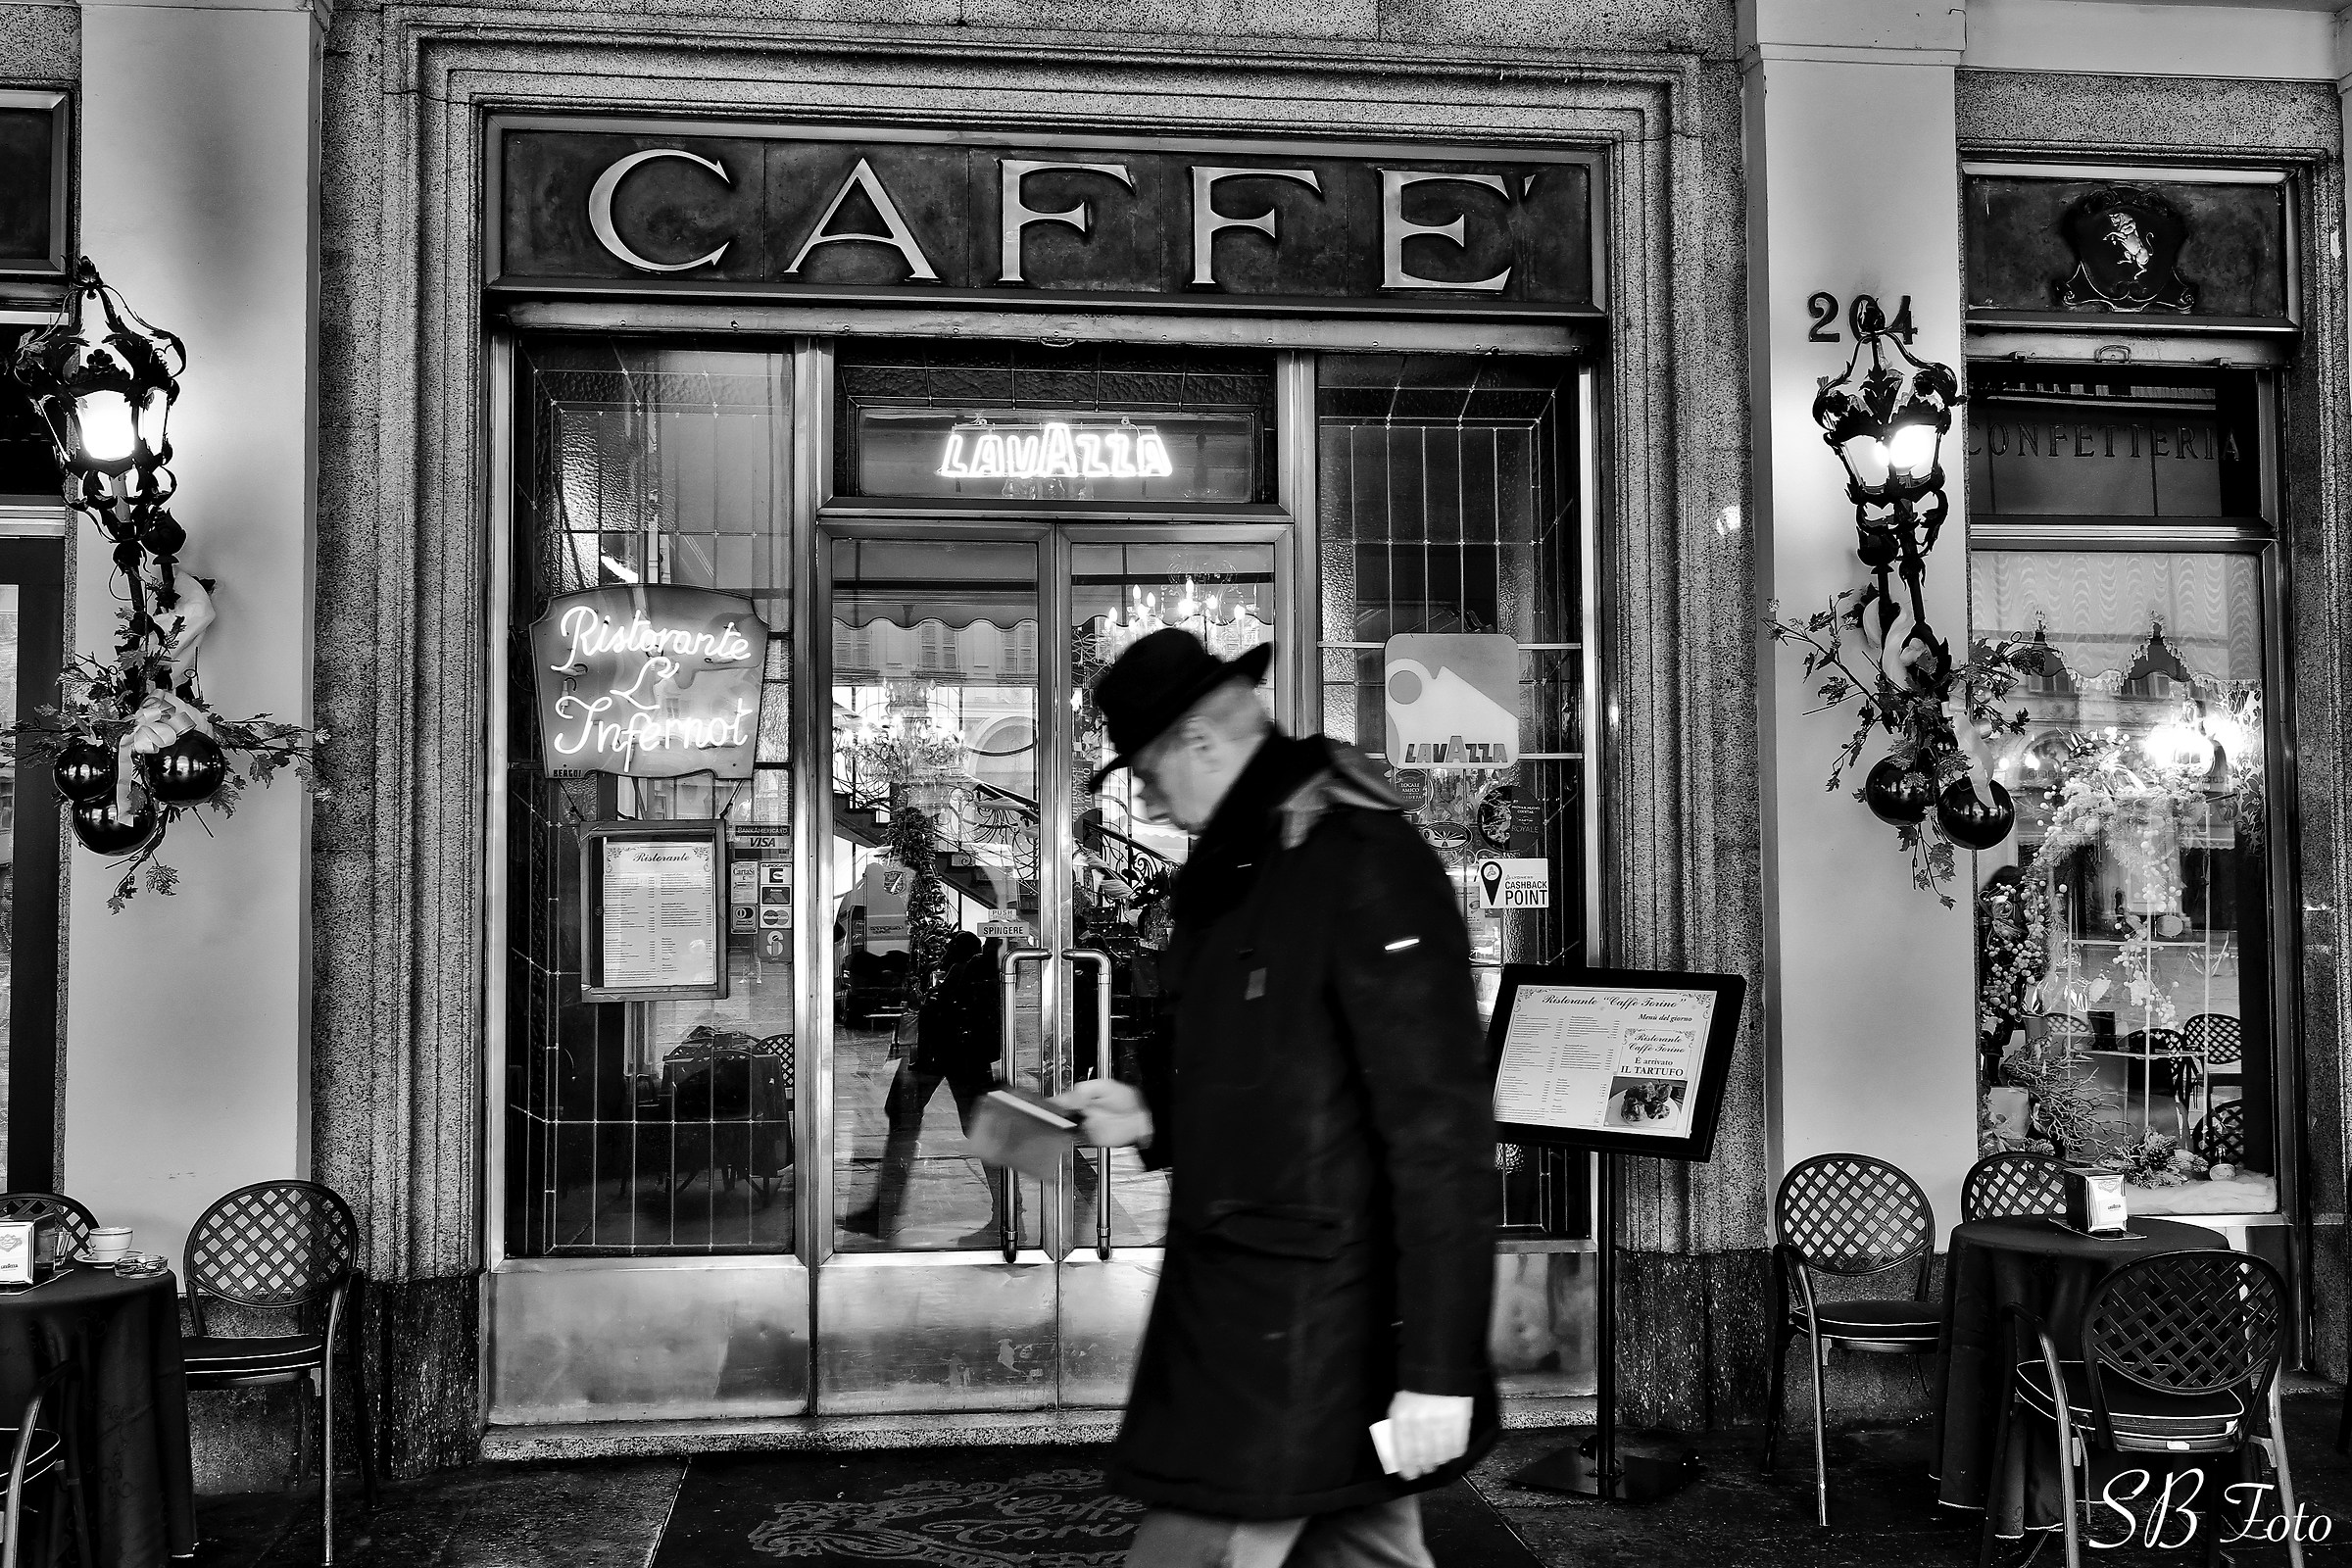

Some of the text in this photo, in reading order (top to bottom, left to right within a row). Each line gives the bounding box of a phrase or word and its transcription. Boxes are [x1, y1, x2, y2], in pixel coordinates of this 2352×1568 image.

[589, 148, 1536, 295] CAFFE'
[1969, 422, 2241, 462] CONFETTERIA
[940, 422, 1172, 478] LAVAZZA
[550, 605, 752, 670] Ristorante
[554, 697, 753, 773] Infernot
[1404, 735, 1509, 763] LAVAZZA
[1511, 825, 1540, 834] ROYALE
[750, 837, 776, 848] VISA
[632, 852, 692, 862] Ristorante
[1504, 880, 1548, 890] CASHBACK
[1505, 889, 1548, 906] POINT
[983, 926, 1024, 935] SPINGERE
[1542, 995, 1599, 1005] Ristorante
[1670, 1014, 1692, 1023] giorno
[1635, 1034, 1683, 1044] Ristorante
[1629, 1043, 1686, 1054] Caffè Torino
[1642, 1057, 1674, 1066] arrivato
[1620, 1065, 1685, 1077] IL TARTUFO
